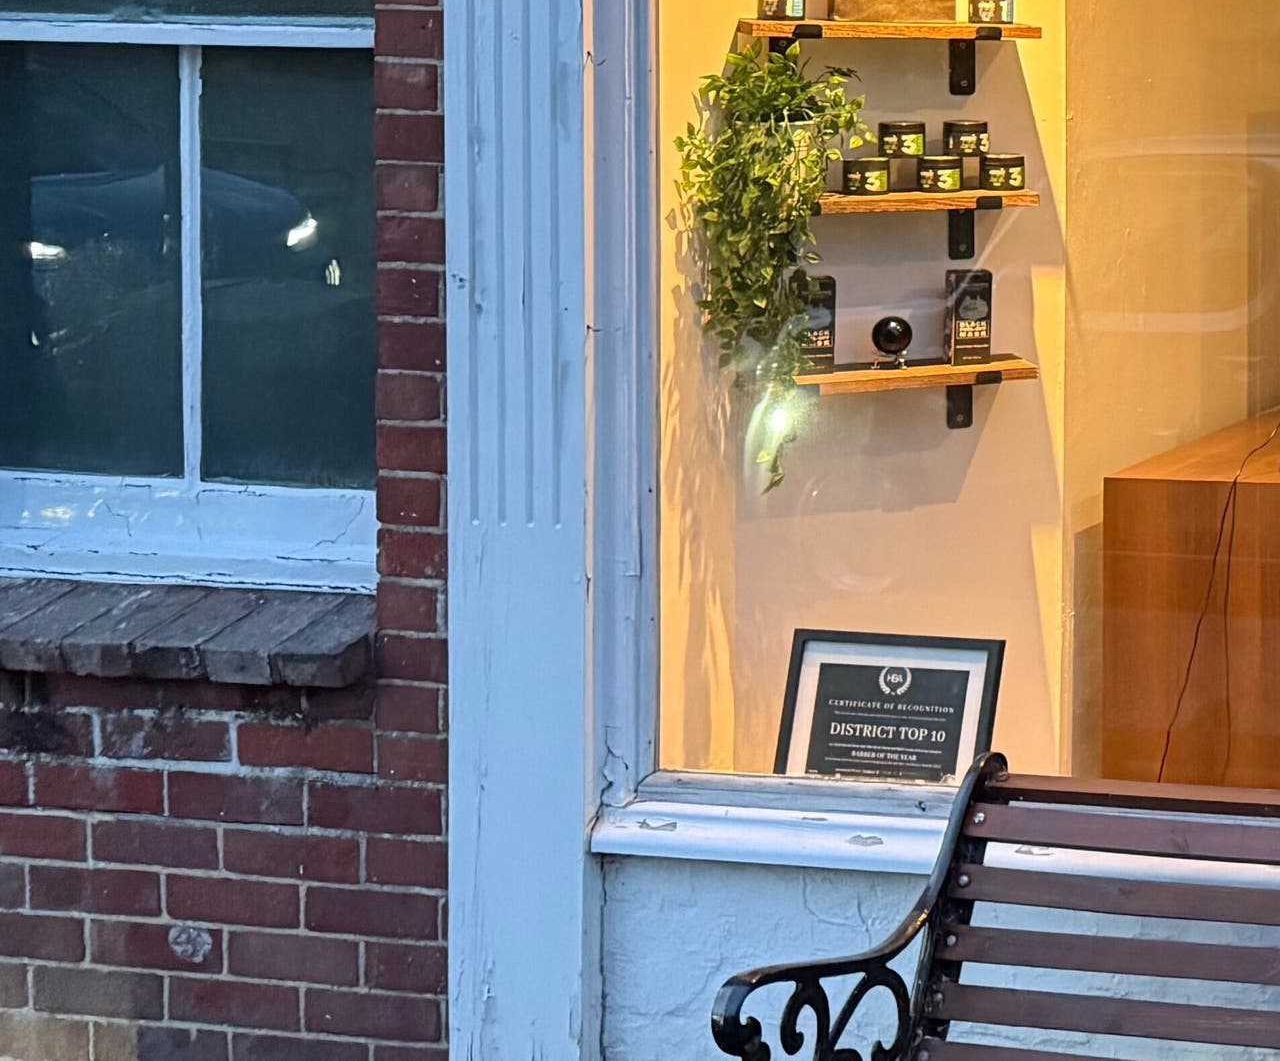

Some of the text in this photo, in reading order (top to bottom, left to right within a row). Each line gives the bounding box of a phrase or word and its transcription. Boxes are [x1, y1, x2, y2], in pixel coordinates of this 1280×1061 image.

[901, 134, 917, 155] 3
[979, 134, 989, 152] 3
[864, 171, 881, 192] 3
[937, 169, 953, 190] 3
[1009, 167, 1022, 187] 3
[829, 699, 955, 714] CERTIFICATE OF RECOGNITION
[830, 722, 946, 742] DISTRICT TOP 10
[851, 750, 876, 758] BARBER
